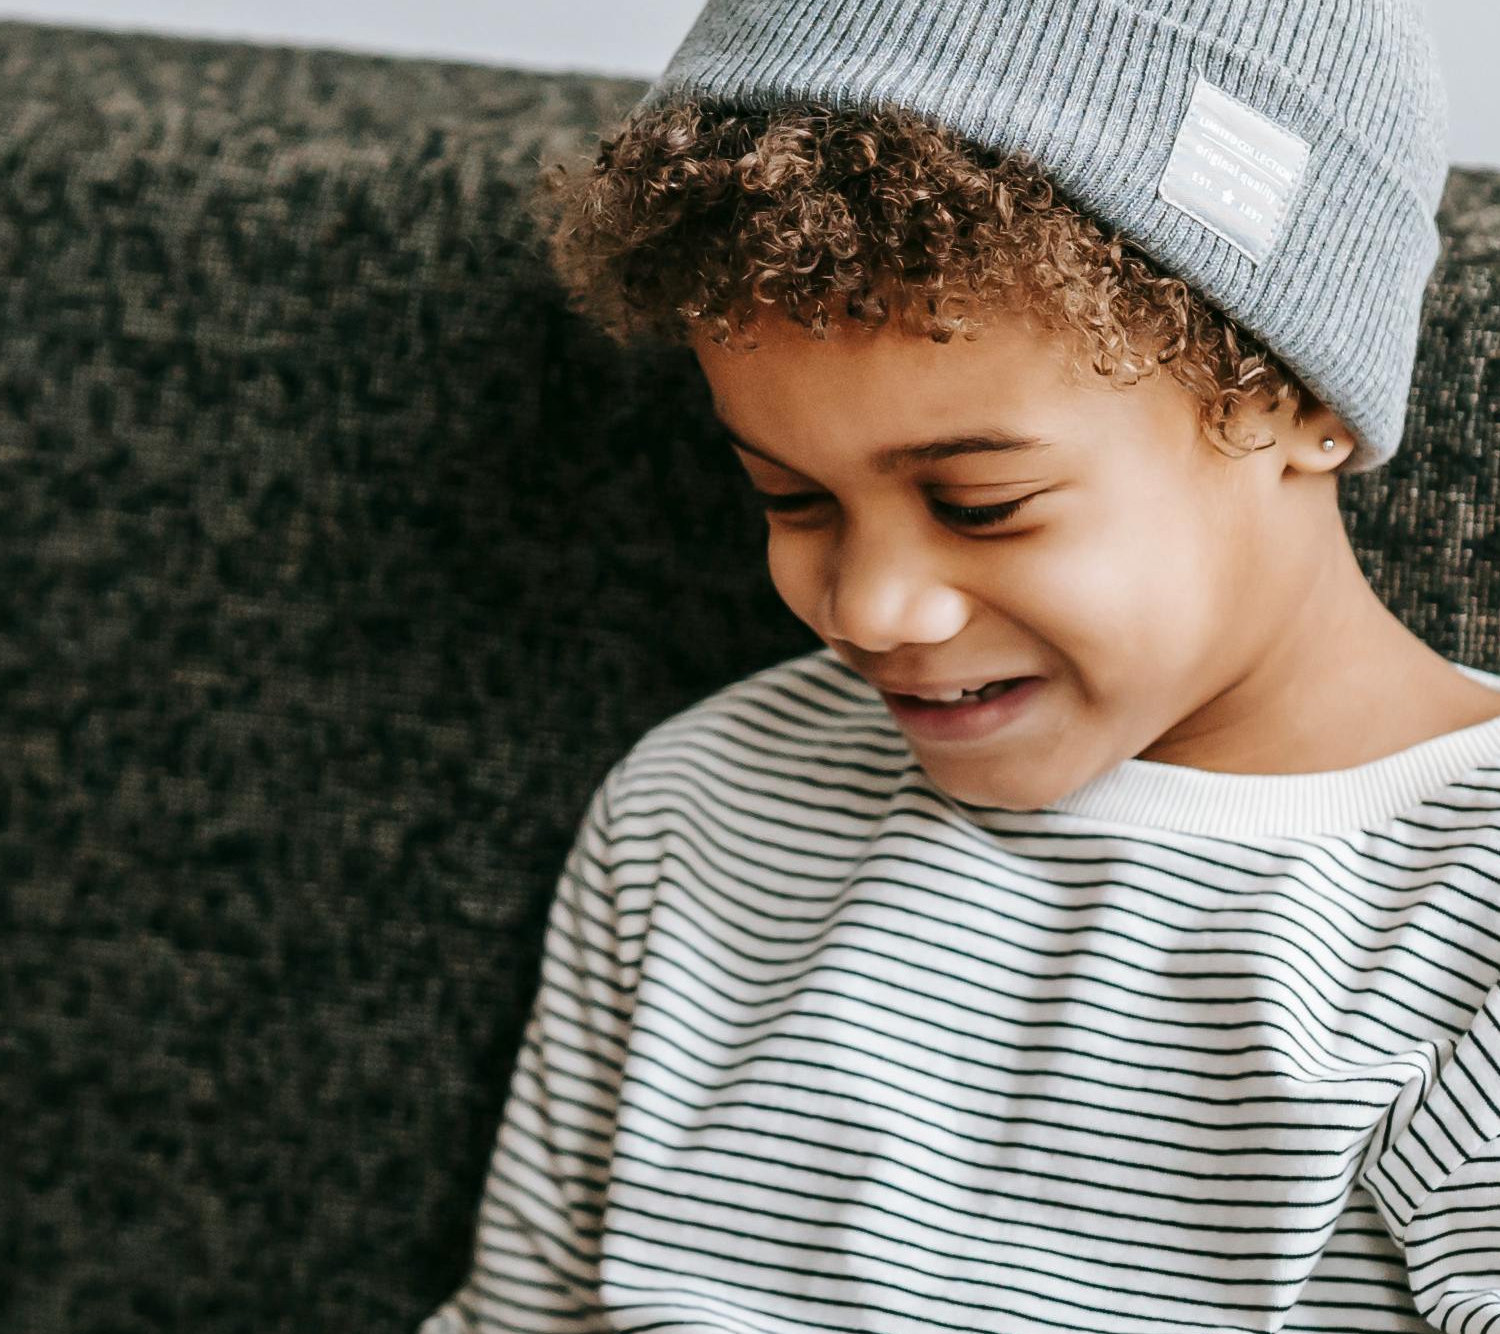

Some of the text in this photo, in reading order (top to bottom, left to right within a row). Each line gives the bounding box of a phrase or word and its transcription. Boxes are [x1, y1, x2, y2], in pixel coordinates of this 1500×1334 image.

[1191, 171, 1213, 192] EST.
[1195, 144, 1278, 205] original quality
